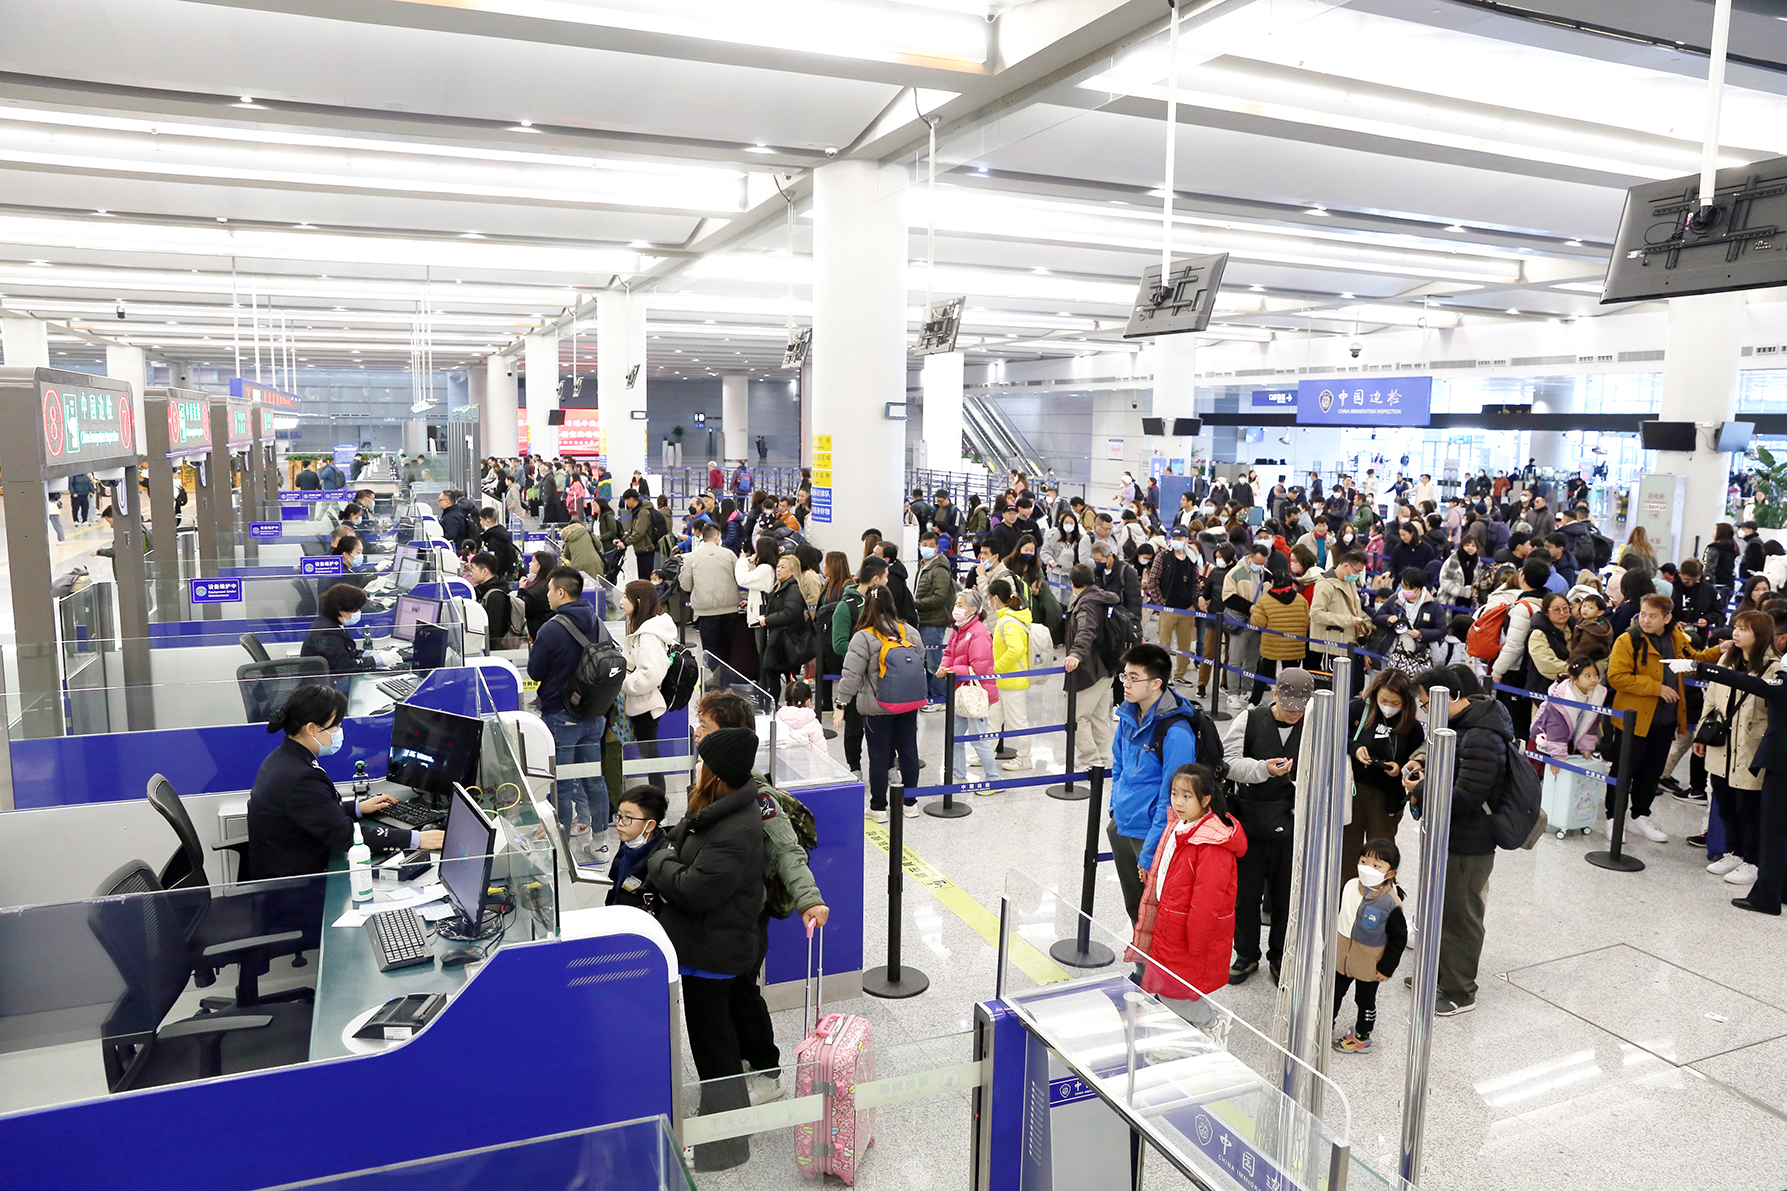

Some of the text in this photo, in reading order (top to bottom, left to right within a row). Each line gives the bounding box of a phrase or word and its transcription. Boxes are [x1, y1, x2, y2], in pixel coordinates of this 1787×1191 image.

[1338, 388, 1402, 407] 中国边检
[49, 404, 59, 441] 8
[1218, 1154, 1261, 1191] CHINA IMMIGR
